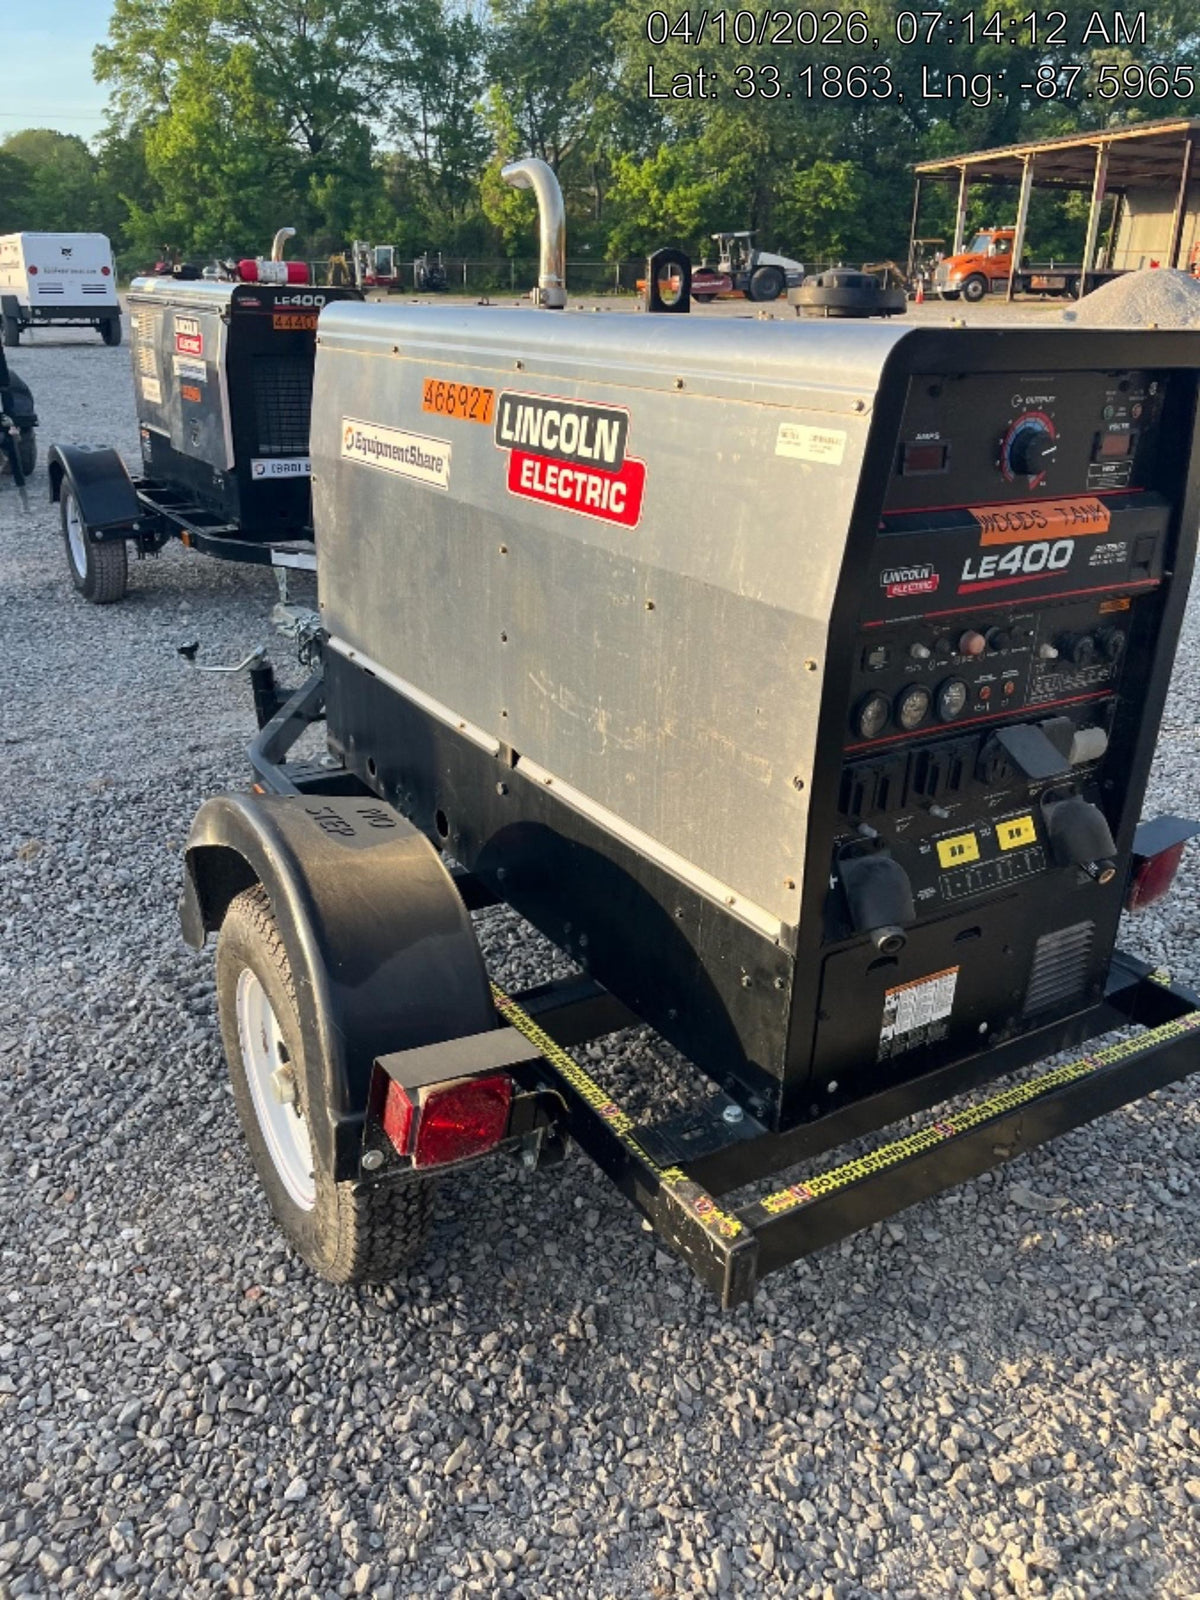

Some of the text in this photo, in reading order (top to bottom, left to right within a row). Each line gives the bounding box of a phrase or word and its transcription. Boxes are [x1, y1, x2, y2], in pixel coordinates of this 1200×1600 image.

[424, 380, 493, 421] 466927
[355, 431, 444, 473] EquipmentShare
[501, 402, 620, 463] LINCOLN
[520, 459, 627, 513] ELECTRIC
[976, 504, 1107, 533] WOODS TANK
[883, 569, 929, 583] LINCOLN
[961, 540, 1075, 580] LE400
[809, 1126, 939, 1193] DO NOT STAND HERE
